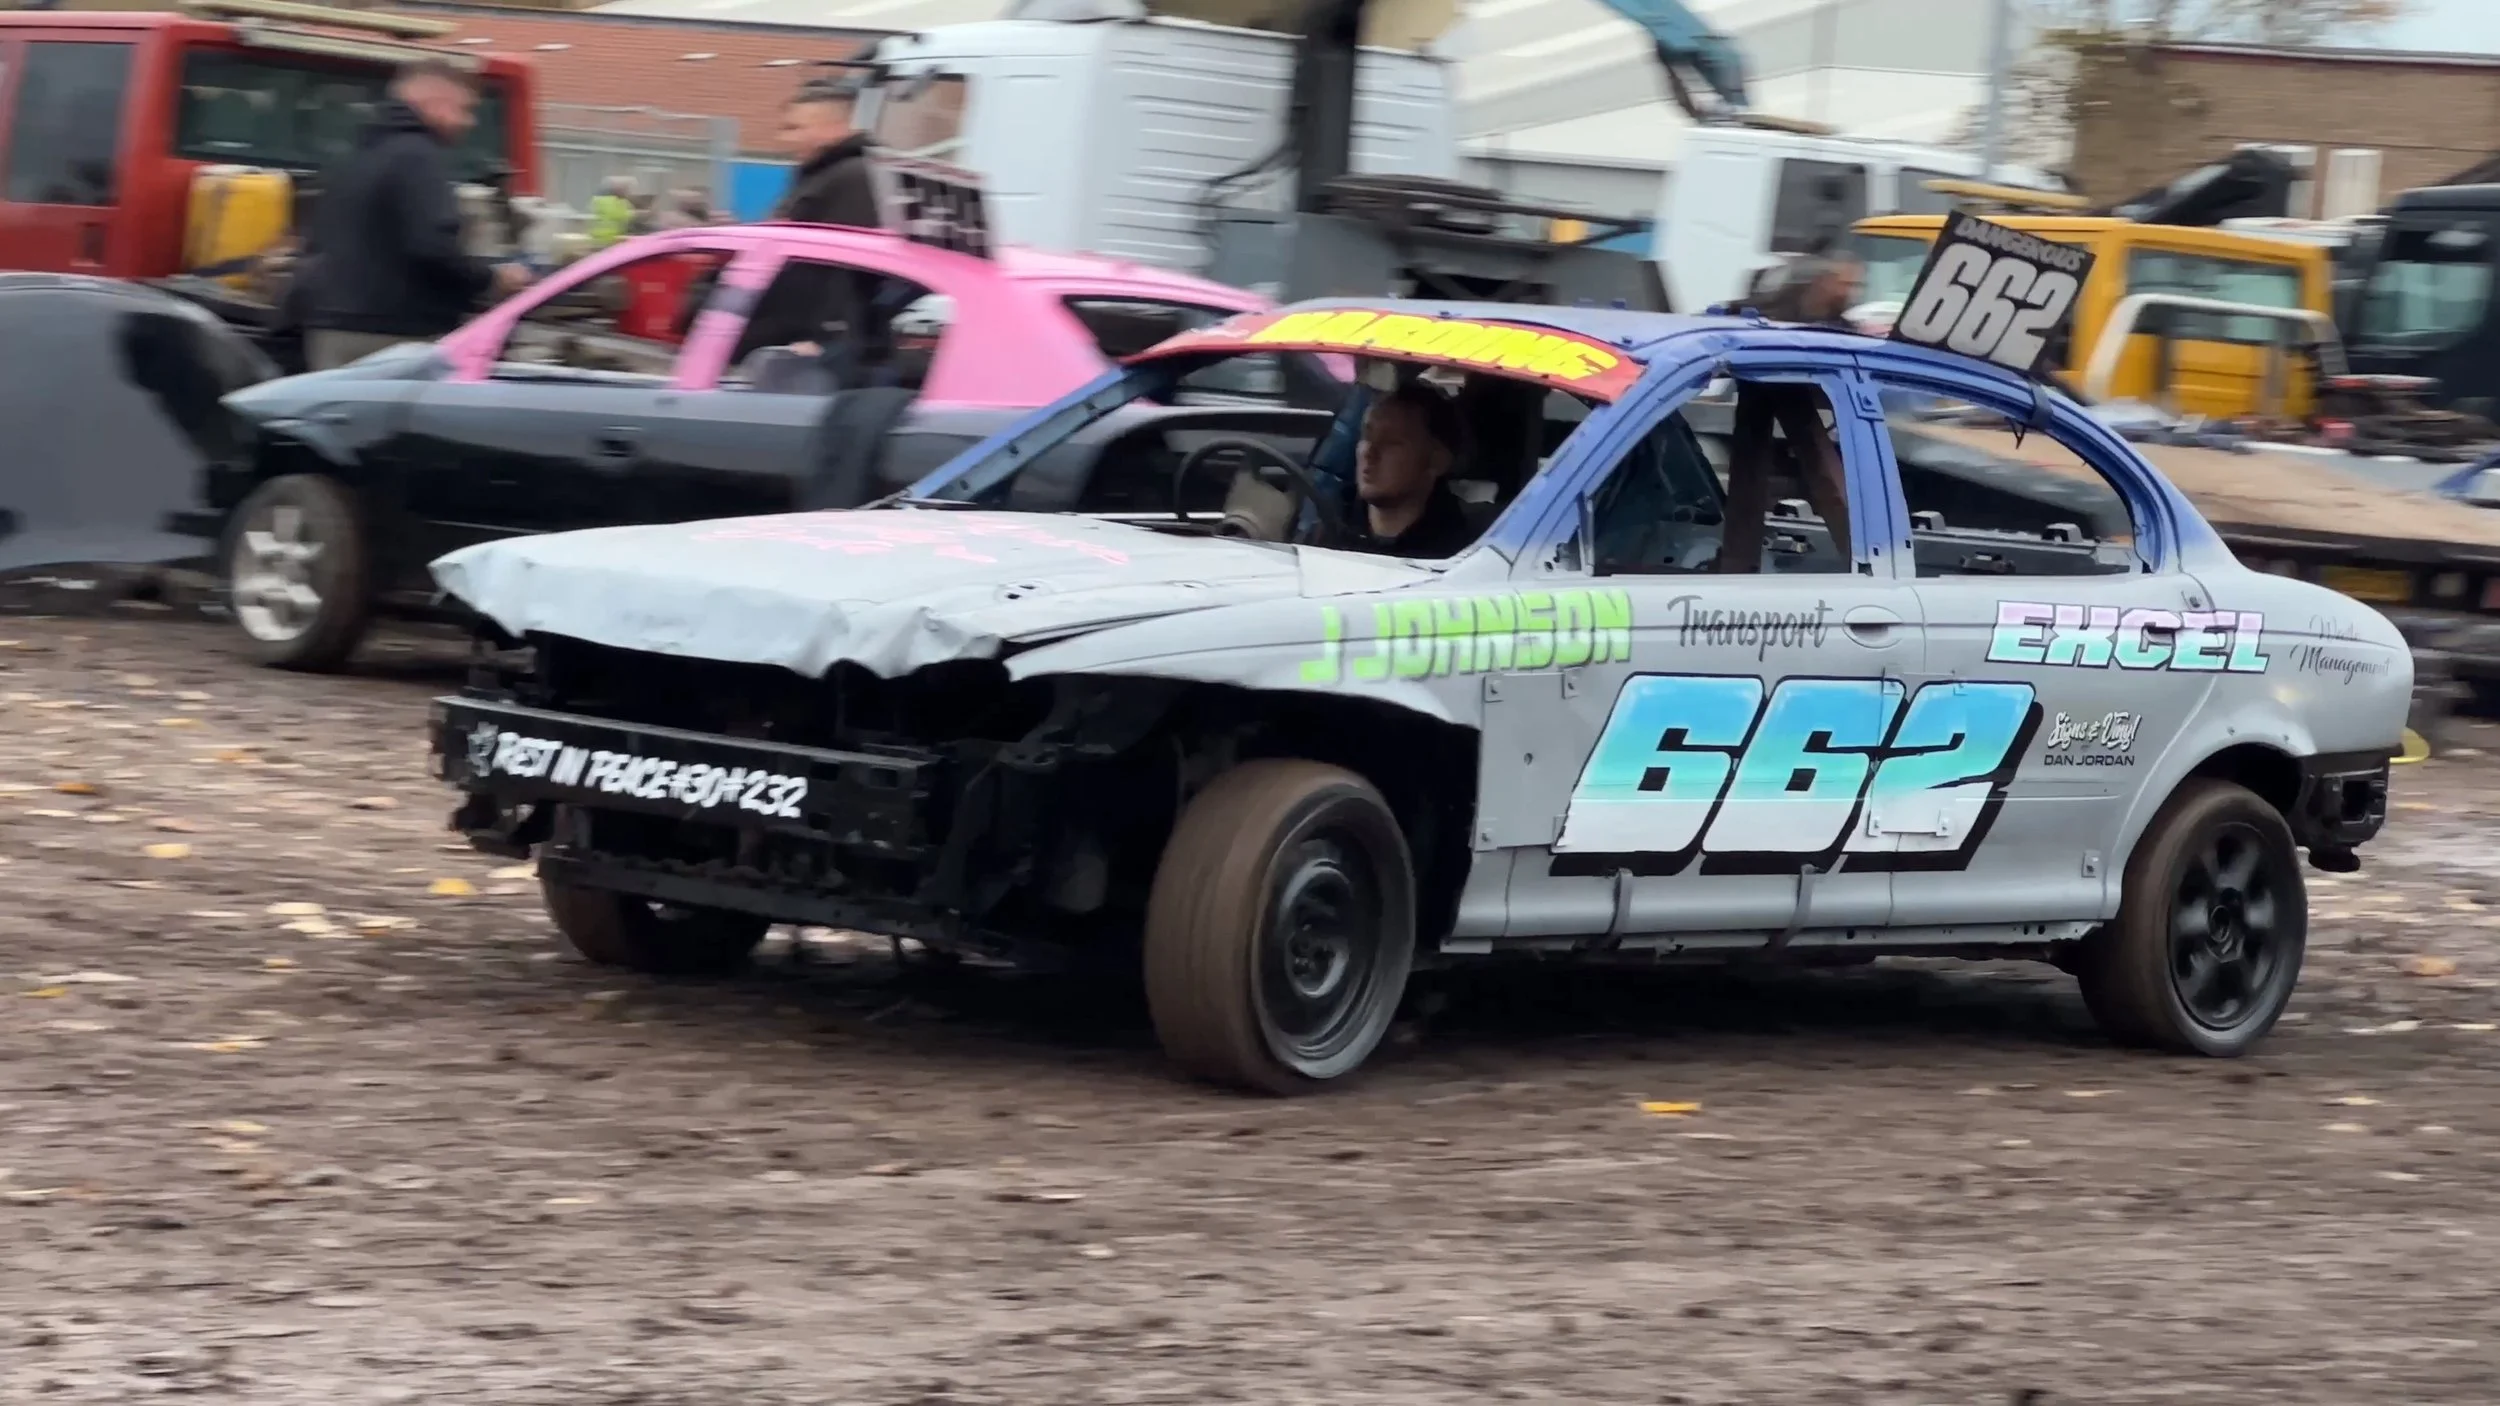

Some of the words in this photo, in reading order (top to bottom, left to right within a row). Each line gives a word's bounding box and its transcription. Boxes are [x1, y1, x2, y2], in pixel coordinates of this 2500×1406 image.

[1953, 217, 2086, 271] DANGEROUS
[1899, 242, 2079, 371] 662
[1300, 604, 1347, 685] J
[1353, 587, 1633, 682] JOHNSON
[1666, 594, 1834, 663] Transport
[1985, 600, 2271, 675] EXCEL
[2044, 754, 2074, 766] DAN
[2075, 755, 2135, 766] JORDAN
[2047, 711, 2088, 751] Signs
[2101, 711, 2142, 752] Vinyl
[550, 746, 590, 787] IN
[1549, 672, 2042, 875] 662
